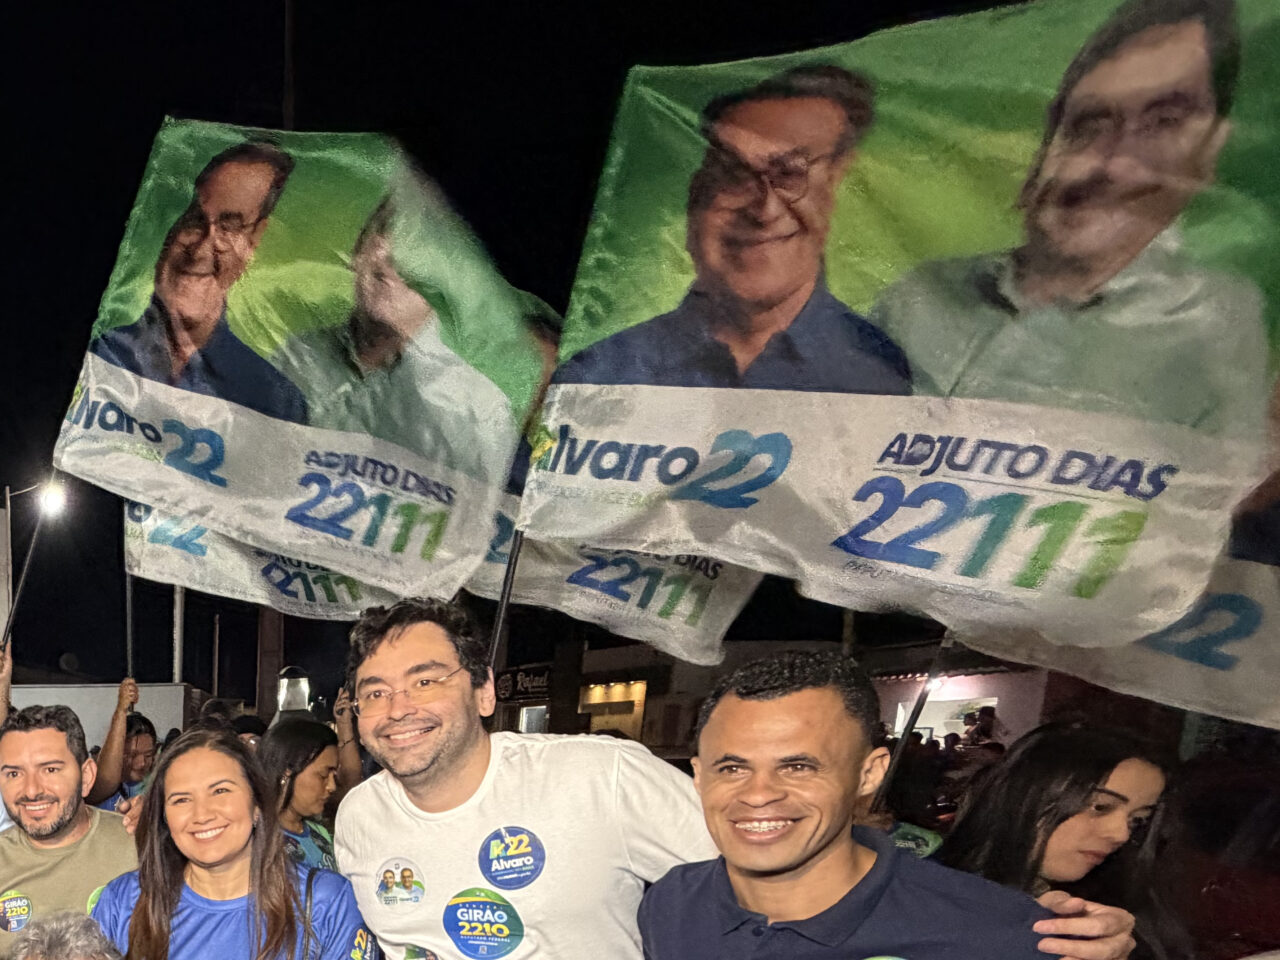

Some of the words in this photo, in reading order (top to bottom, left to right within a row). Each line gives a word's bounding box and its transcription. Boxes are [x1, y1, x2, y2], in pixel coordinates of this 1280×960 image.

[531, 424, 700, 485] lvaro
[876, 432, 1049, 479] ADJUTO
[1051, 450, 1180, 501] DIAS
[285, 472, 449, 562] 22111
[830, 475, 1149, 599] 22111
[491, 856, 534, 872] Alvaro
[6, 906, 28, 917] 2210
[456, 907, 508, 924] GIRÃO
[458, 921, 510, 937] 2210
